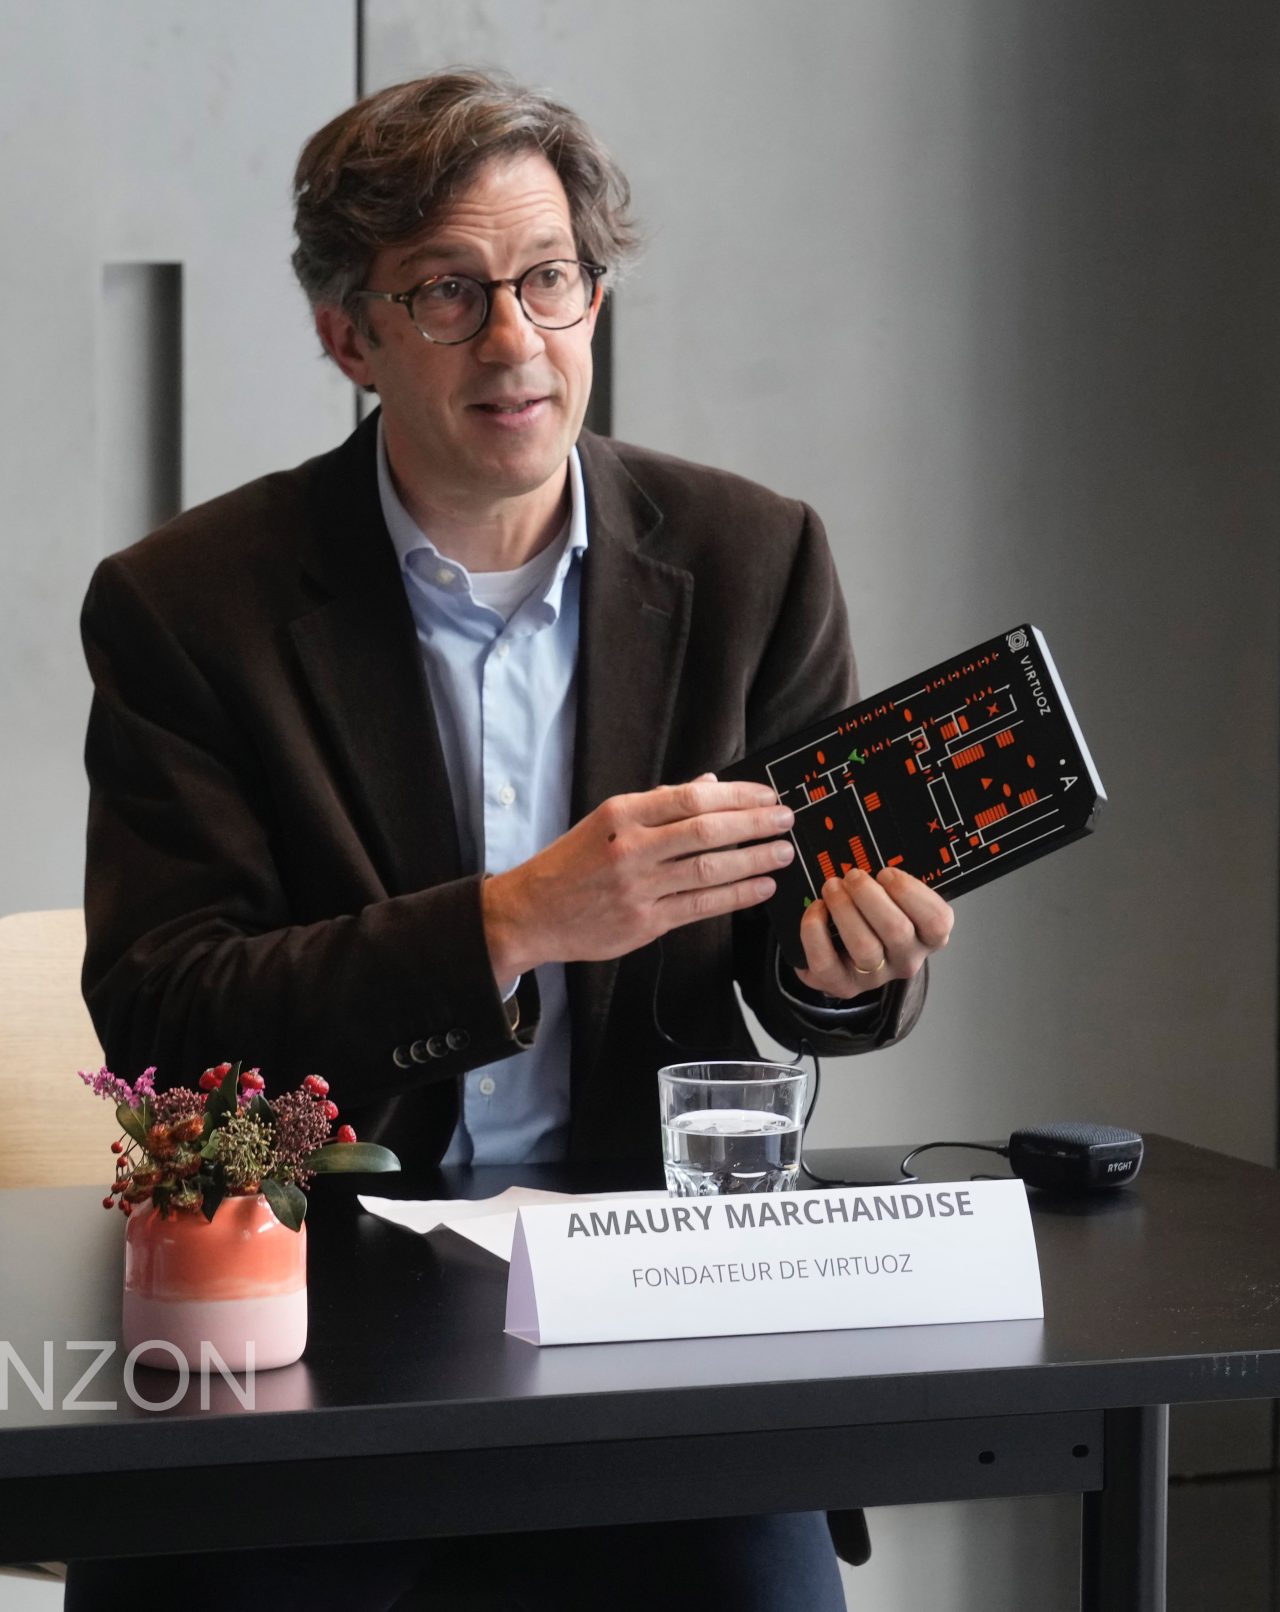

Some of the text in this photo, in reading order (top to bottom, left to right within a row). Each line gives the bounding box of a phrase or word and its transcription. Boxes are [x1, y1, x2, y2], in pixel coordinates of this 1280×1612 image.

[1020, 655, 1051, 716] VIRTUOZ
[1059, 775, 1079, 792] A
[567, 1191, 974, 1238] AMAURY MARCHANDISE
[632, 1253, 913, 1288] FONDATEUR DE VIRTUOZ
